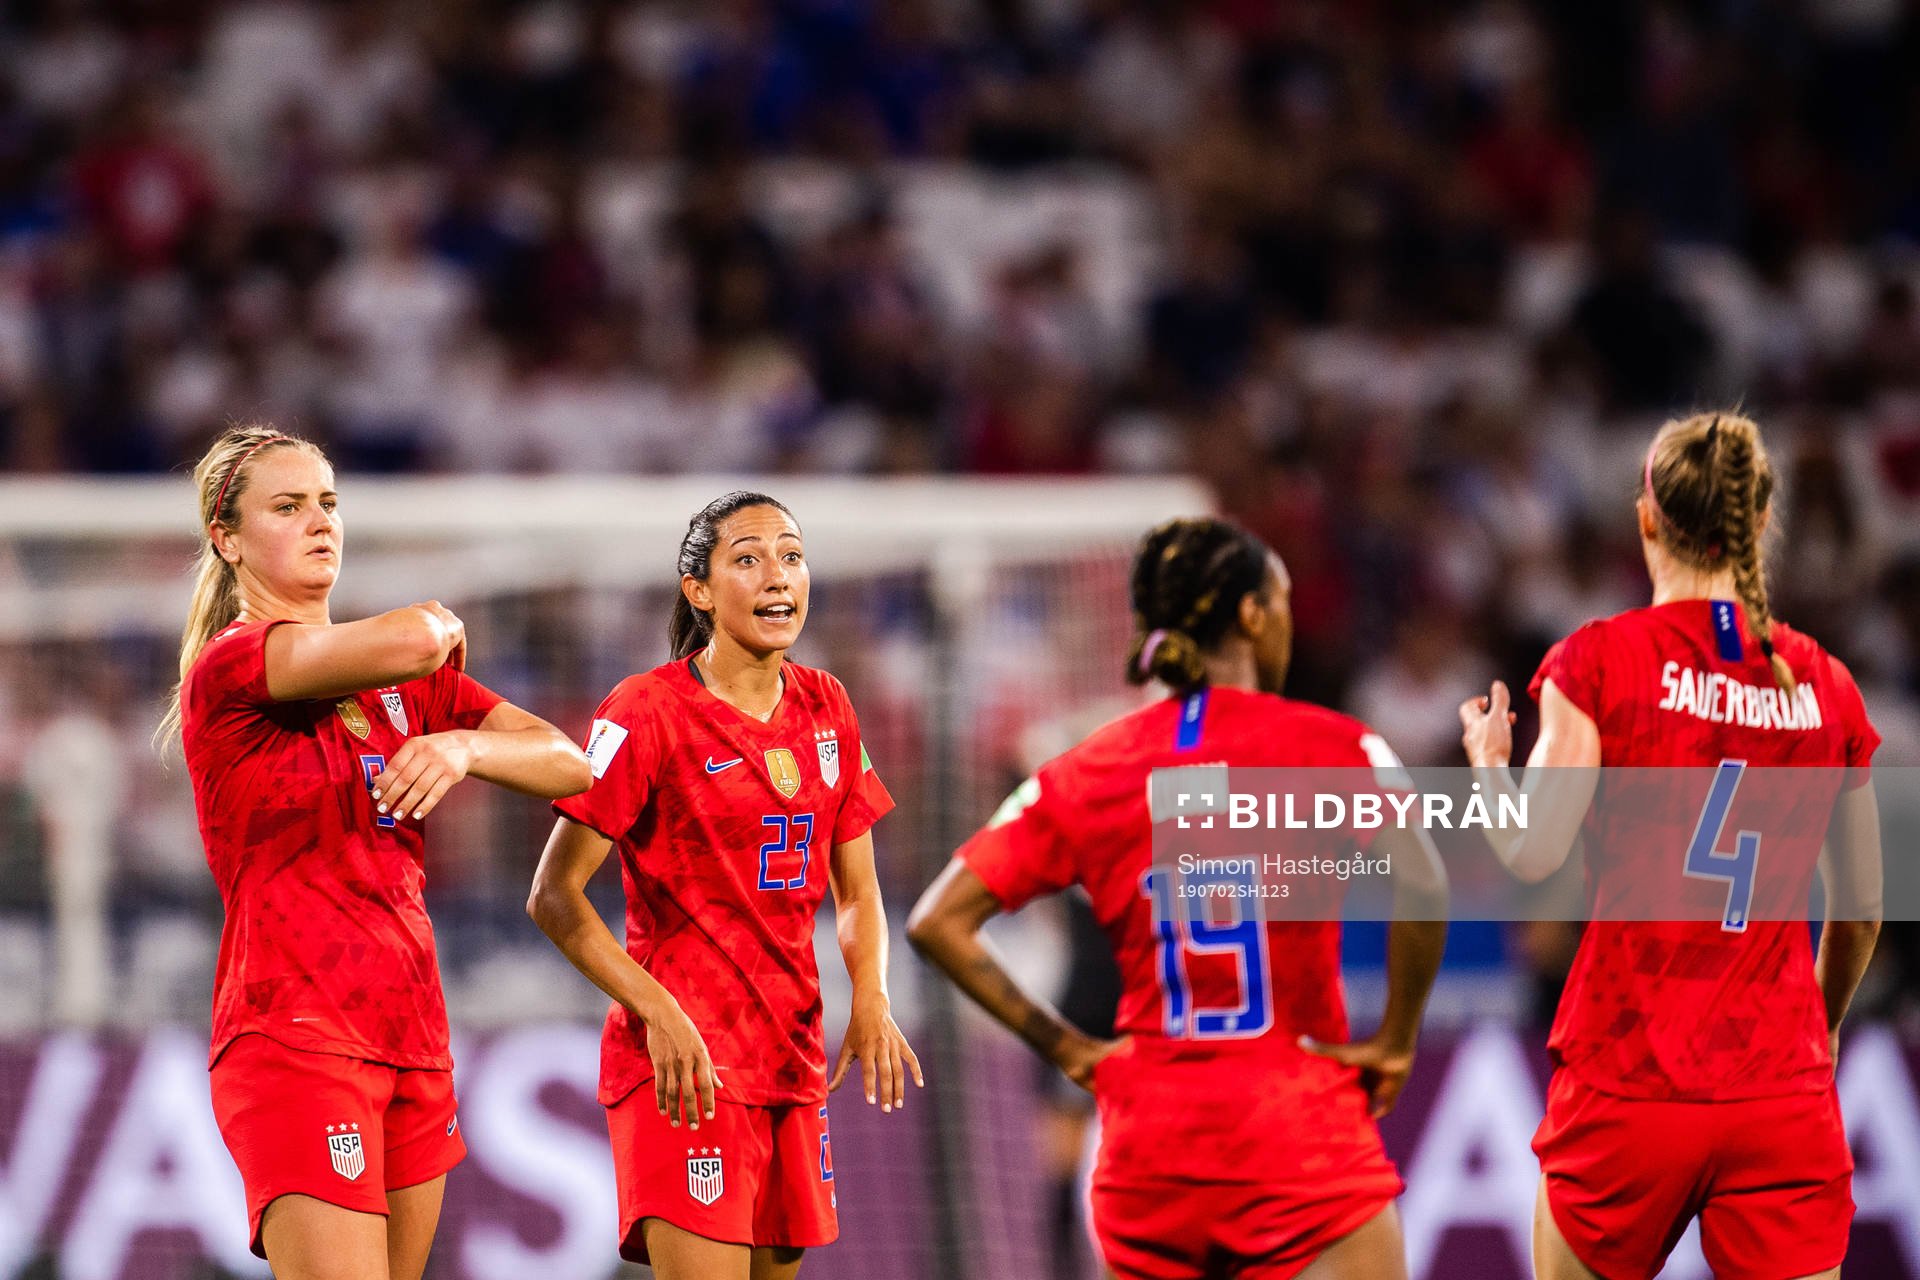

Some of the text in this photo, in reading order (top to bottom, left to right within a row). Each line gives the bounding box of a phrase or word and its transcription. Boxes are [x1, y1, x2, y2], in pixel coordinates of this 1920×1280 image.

[383, 695, 401, 712] USA
[818, 743, 837, 762] USA
[758, 812, 815, 891] 23
[1682, 758, 1762, 933] 4
[1138, 854, 1275, 1040] 19
[331, 1136, 360, 1154] USA
[690, 1161, 720, 1178] USA
